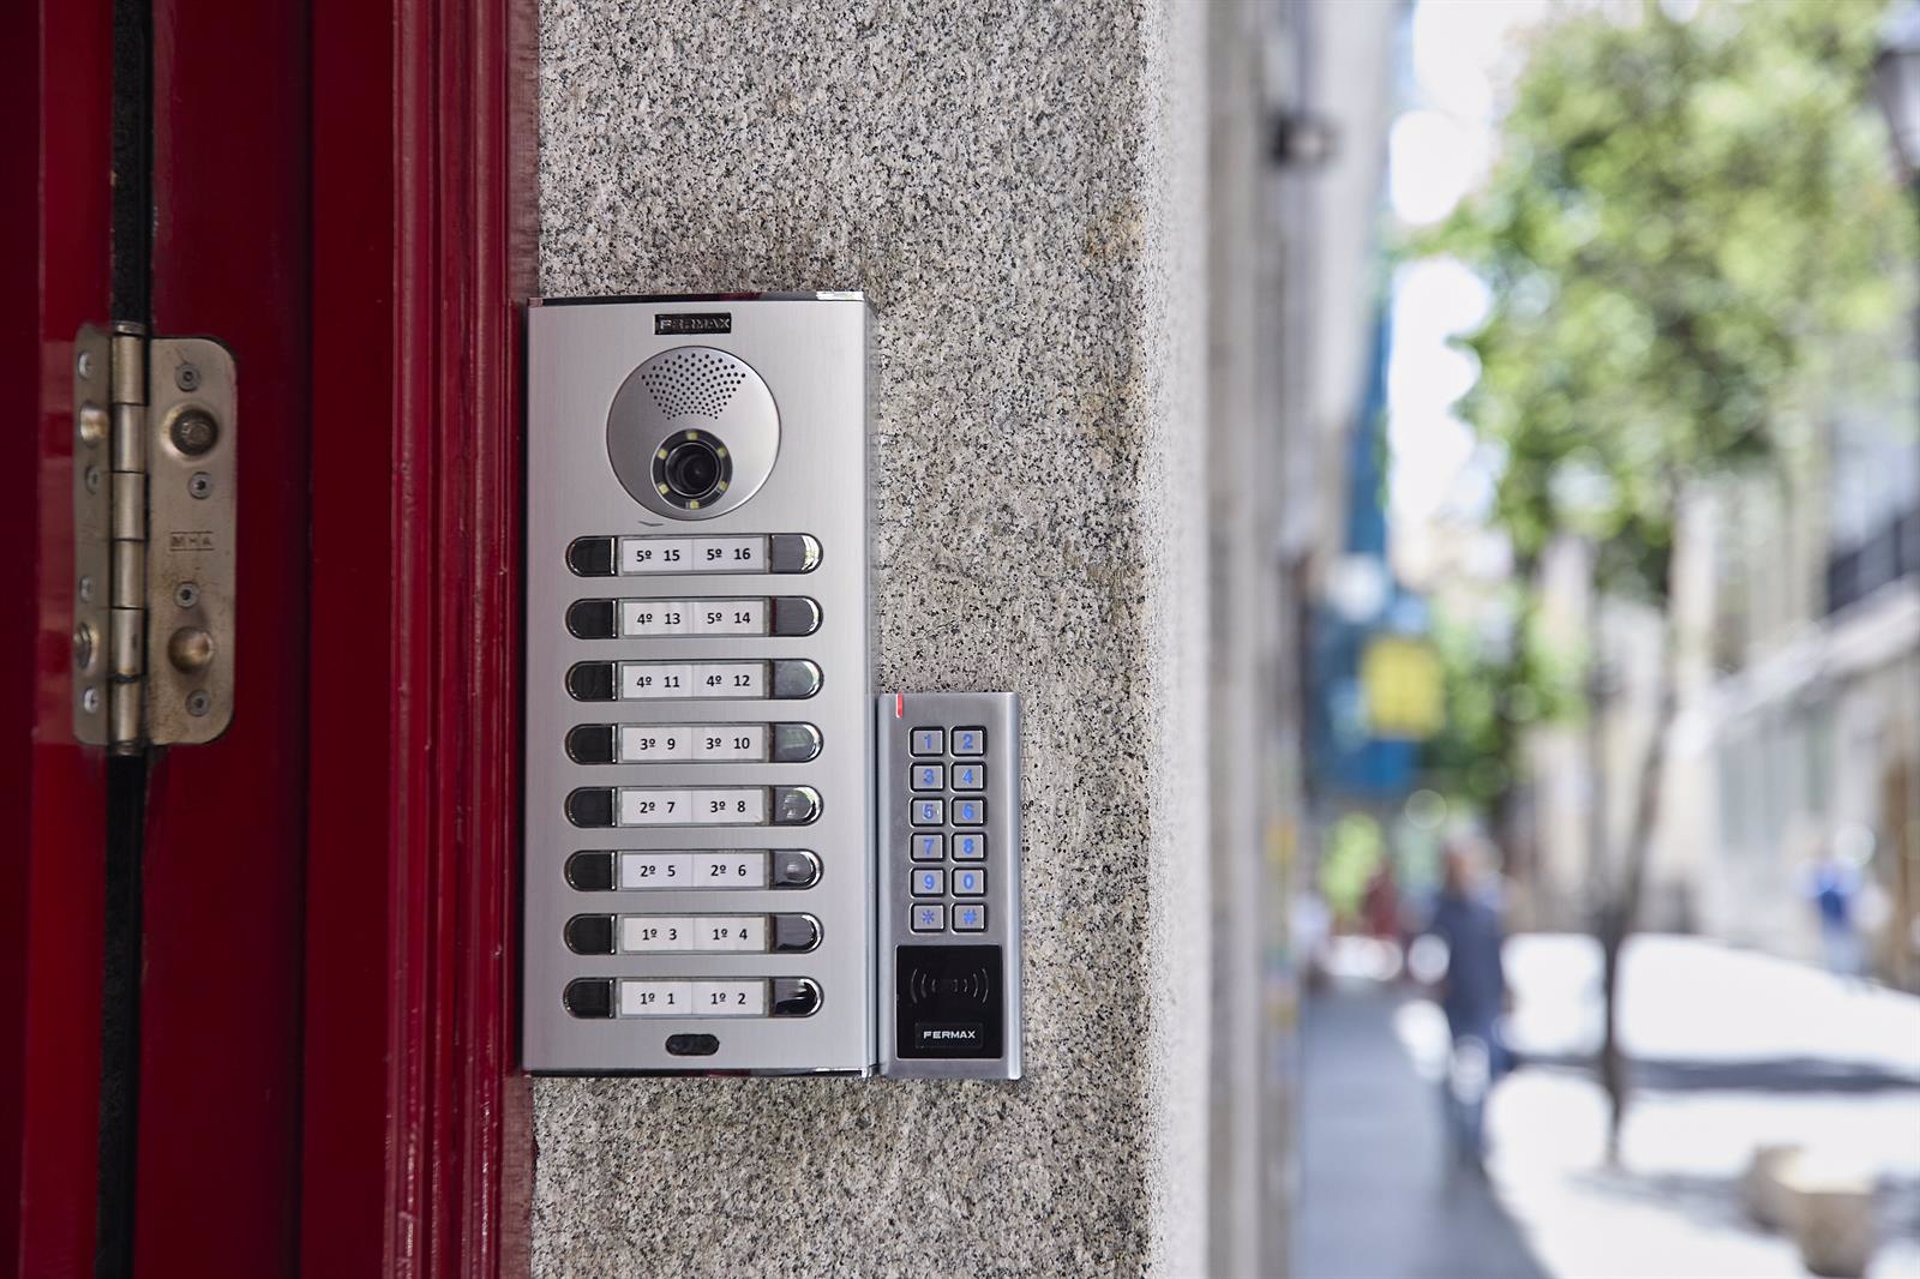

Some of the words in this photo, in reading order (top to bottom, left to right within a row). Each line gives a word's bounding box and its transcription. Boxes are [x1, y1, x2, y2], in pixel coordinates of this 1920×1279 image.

[663, 549, 681, 562] 15
[734, 547, 751, 560] 16
[664, 612, 681, 625] 13
[734, 611, 751, 624] 14
[664, 675, 680, 688] 11
[734, 674, 750, 687] 12
[667, 737, 676, 751] 9
[733, 737, 751, 750] 10
[925, 735, 933, 749] 1
[962, 733, 973, 749] 2
[923, 769, 935, 785] 3
[962, 769, 974, 785] 4
[666, 801, 676, 814] 7
[737, 800, 746, 813] 8
[923, 803, 934, 820] 5
[962, 803, 975, 820] 6
[924, 838, 935, 855] 7
[962, 838, 975, 855] 8
[667, 864, 676, 878] 5
[738, 864, 747, 877] 6
[923, 873, 936, 890] 9
[962, 873, 975, 890] 0
[669, 928, 678, 941] 3
[739, 928, 748, 940] 4
[668, 992, 675, 1005] 1
[737, 992, 746, 1005] 2
[923, 1030, 976, 1039] FERMAX
